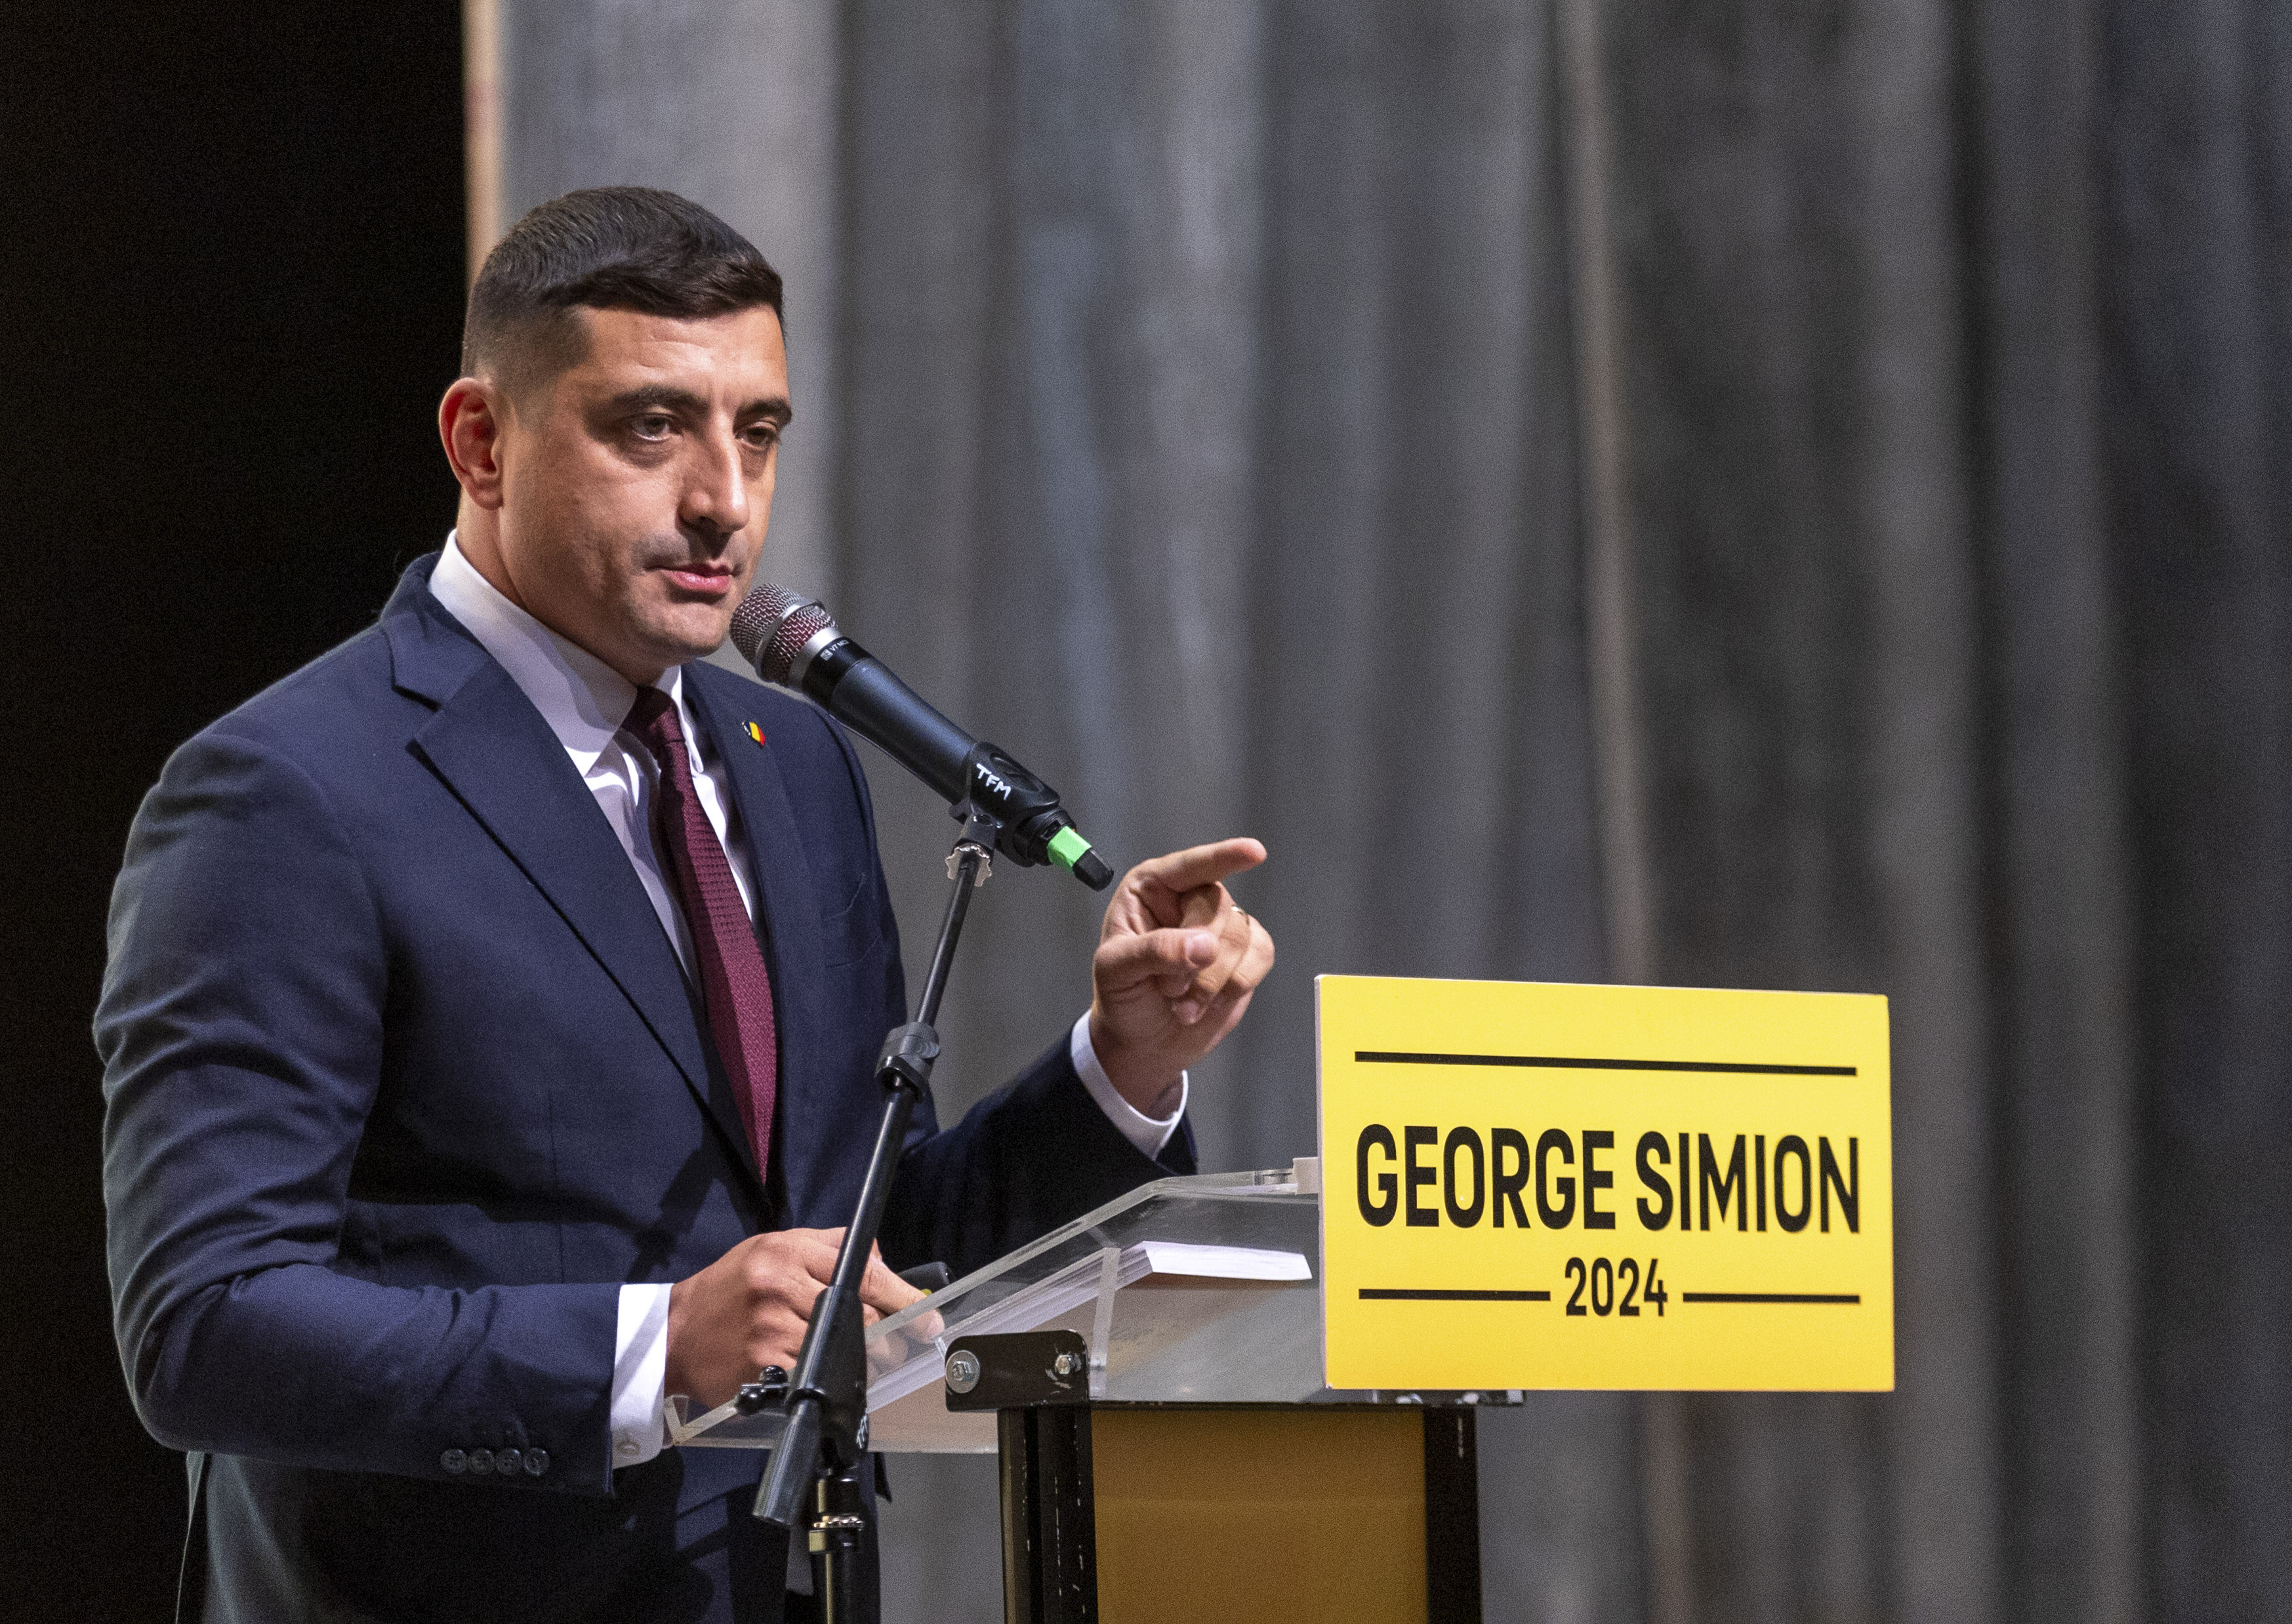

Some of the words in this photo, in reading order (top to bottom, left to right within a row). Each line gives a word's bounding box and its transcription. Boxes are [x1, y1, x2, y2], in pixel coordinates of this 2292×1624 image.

[976, 763, 1012, 800] TFM
[1356, 1123, 1616, 1230] GEORGE
[1635, 1131, 1860, 1234] SIMION
[1564, 1256, 1668, 1317] 2024
